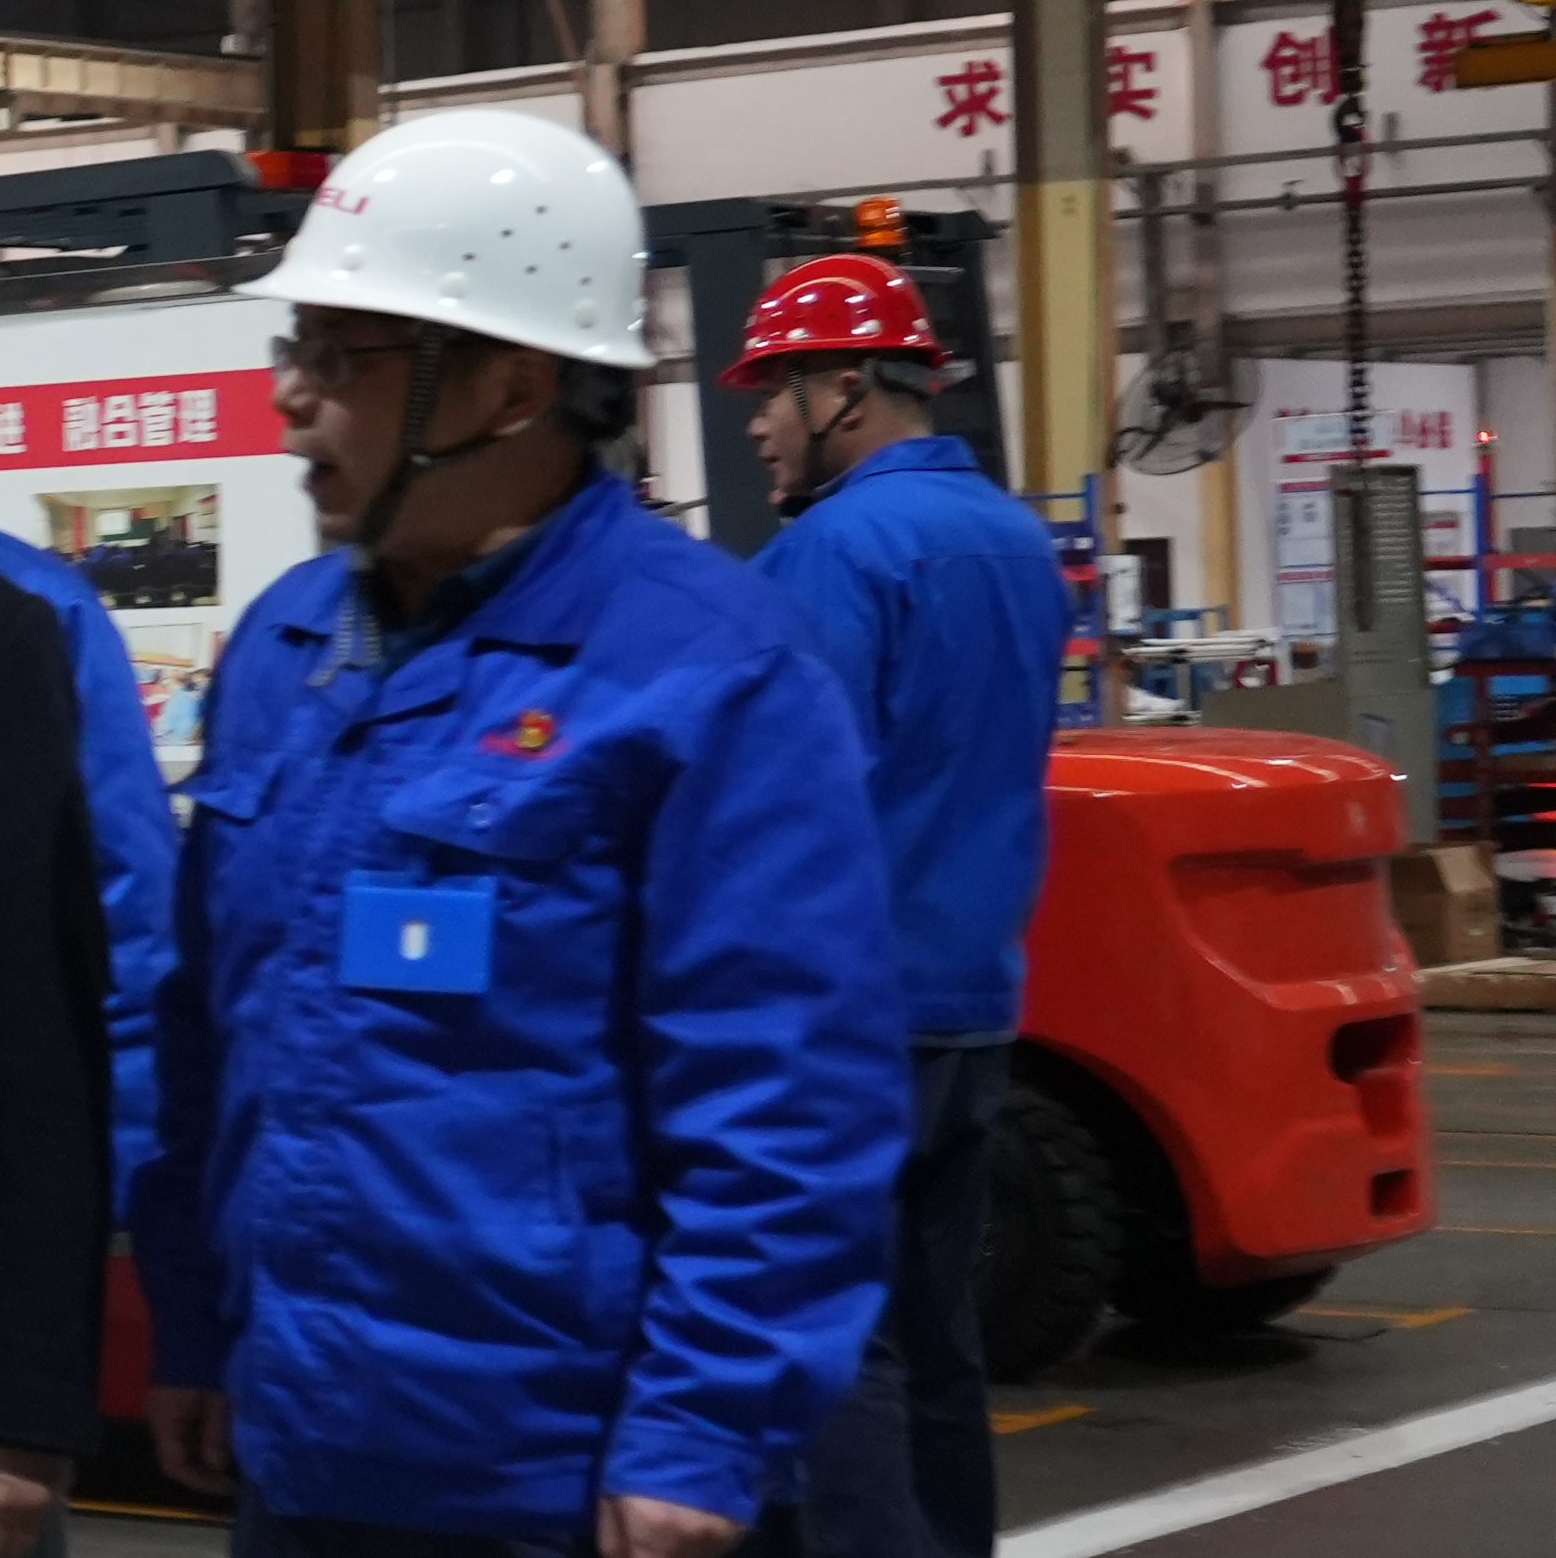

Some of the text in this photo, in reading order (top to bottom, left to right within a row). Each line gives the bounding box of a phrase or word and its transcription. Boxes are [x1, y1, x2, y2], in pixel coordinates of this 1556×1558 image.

[317, 187, 371, 215] ELI
[62, 389, 218, 451] 融合管理
